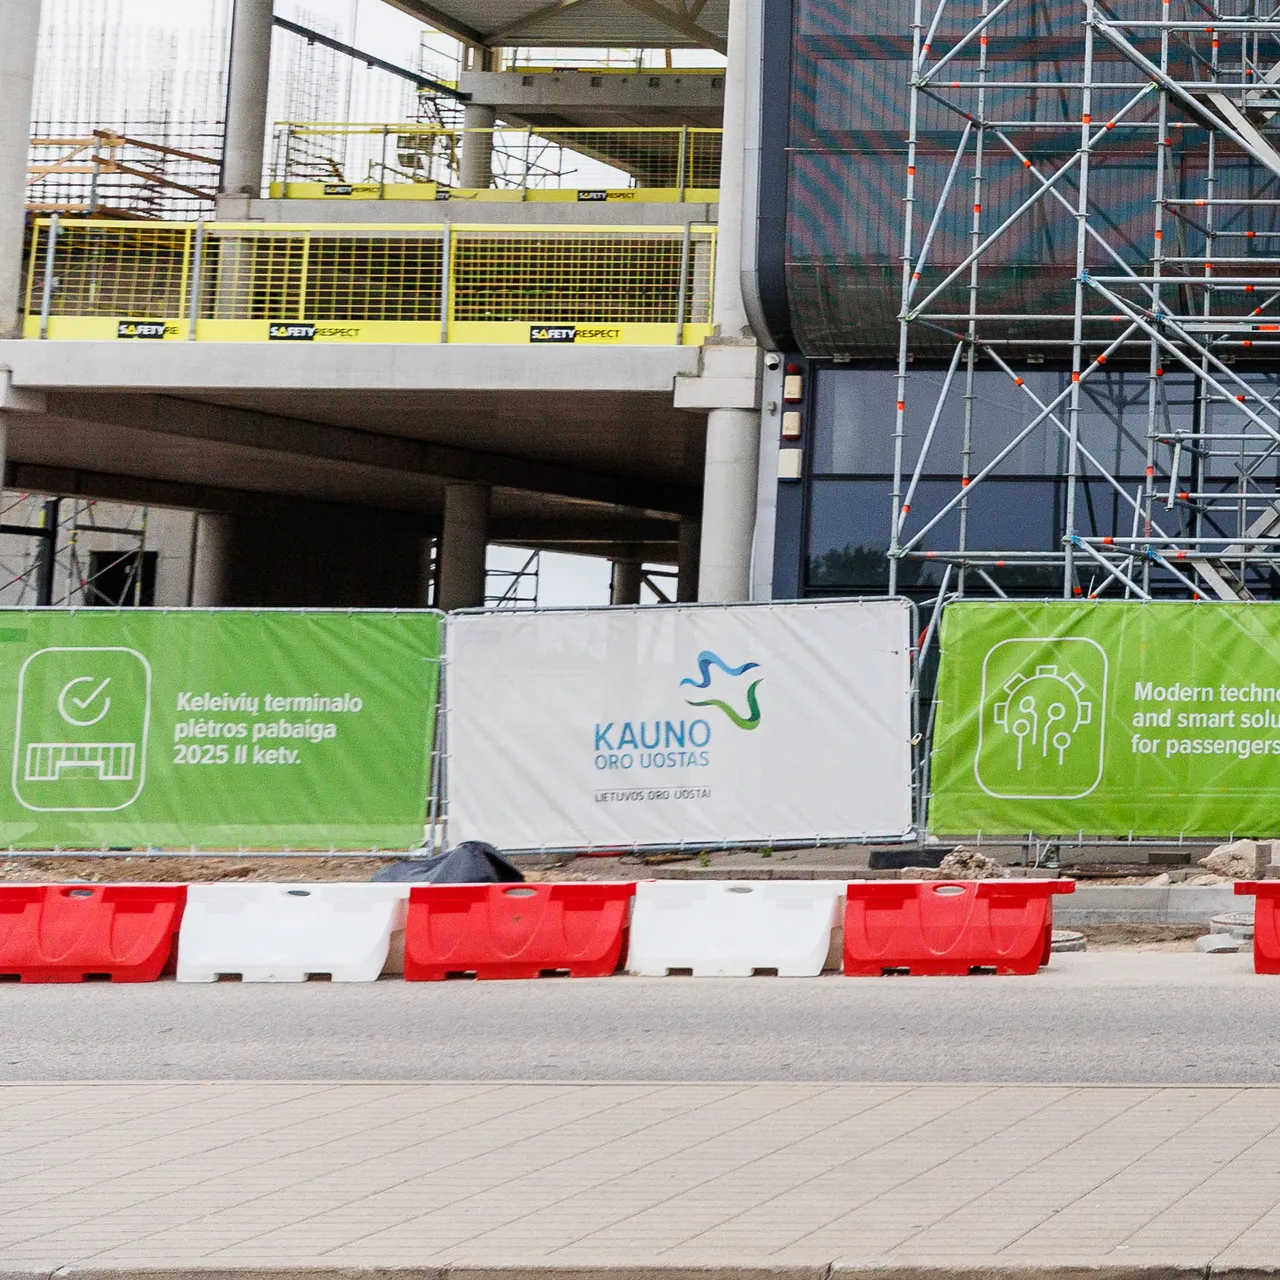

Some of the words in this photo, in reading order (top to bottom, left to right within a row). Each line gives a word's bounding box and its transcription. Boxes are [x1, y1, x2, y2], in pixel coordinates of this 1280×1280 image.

[1134, 682, 1214, 702] Modern
[176, 692, 259, 716] Keleivių
[263, 693, 363, 713] terminalo
[1132, 709, 1172, 728] and
[1177, 710, 1235, 729] smart
[174, 718, 248, 742] plėtros
[252, 720, 337, 743] pabaiga
[595, 719, 711, 751] KAUNO
[1131, 734, 1160, 754] for
[173, 745, 229, 764] 2025
[234, 745, 248, 764] II
[252, 745, 301, 764] ketv.
[595, 753, 633, 770] ORO
[640, 751, 710, 769] UOSTAS
[595, 791, 645, 803] LIETUVOS
[648, 790, 670, 801] ORO
[674, 789, 711, 800] UOSTAI
